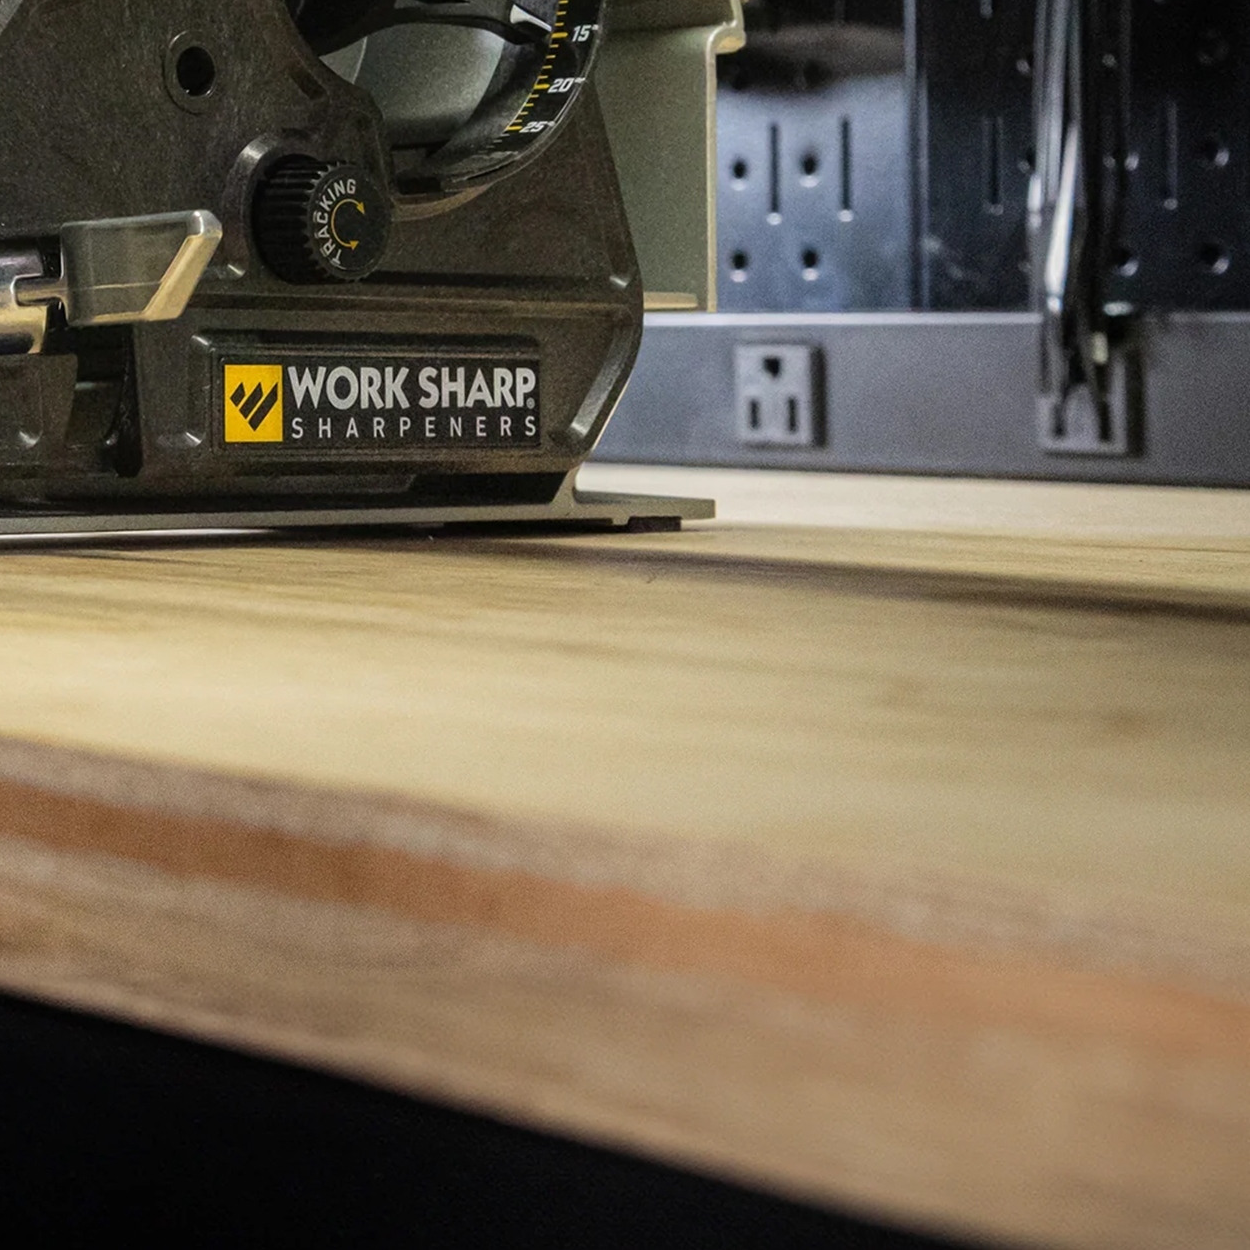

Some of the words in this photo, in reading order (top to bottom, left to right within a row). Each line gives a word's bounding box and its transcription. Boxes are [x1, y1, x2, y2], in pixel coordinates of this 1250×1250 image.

[315, 178, 357, 265] TRACKING
[287, 365, 410, 410] WORK
[291, 415, 538, 439] SHARPENERS
